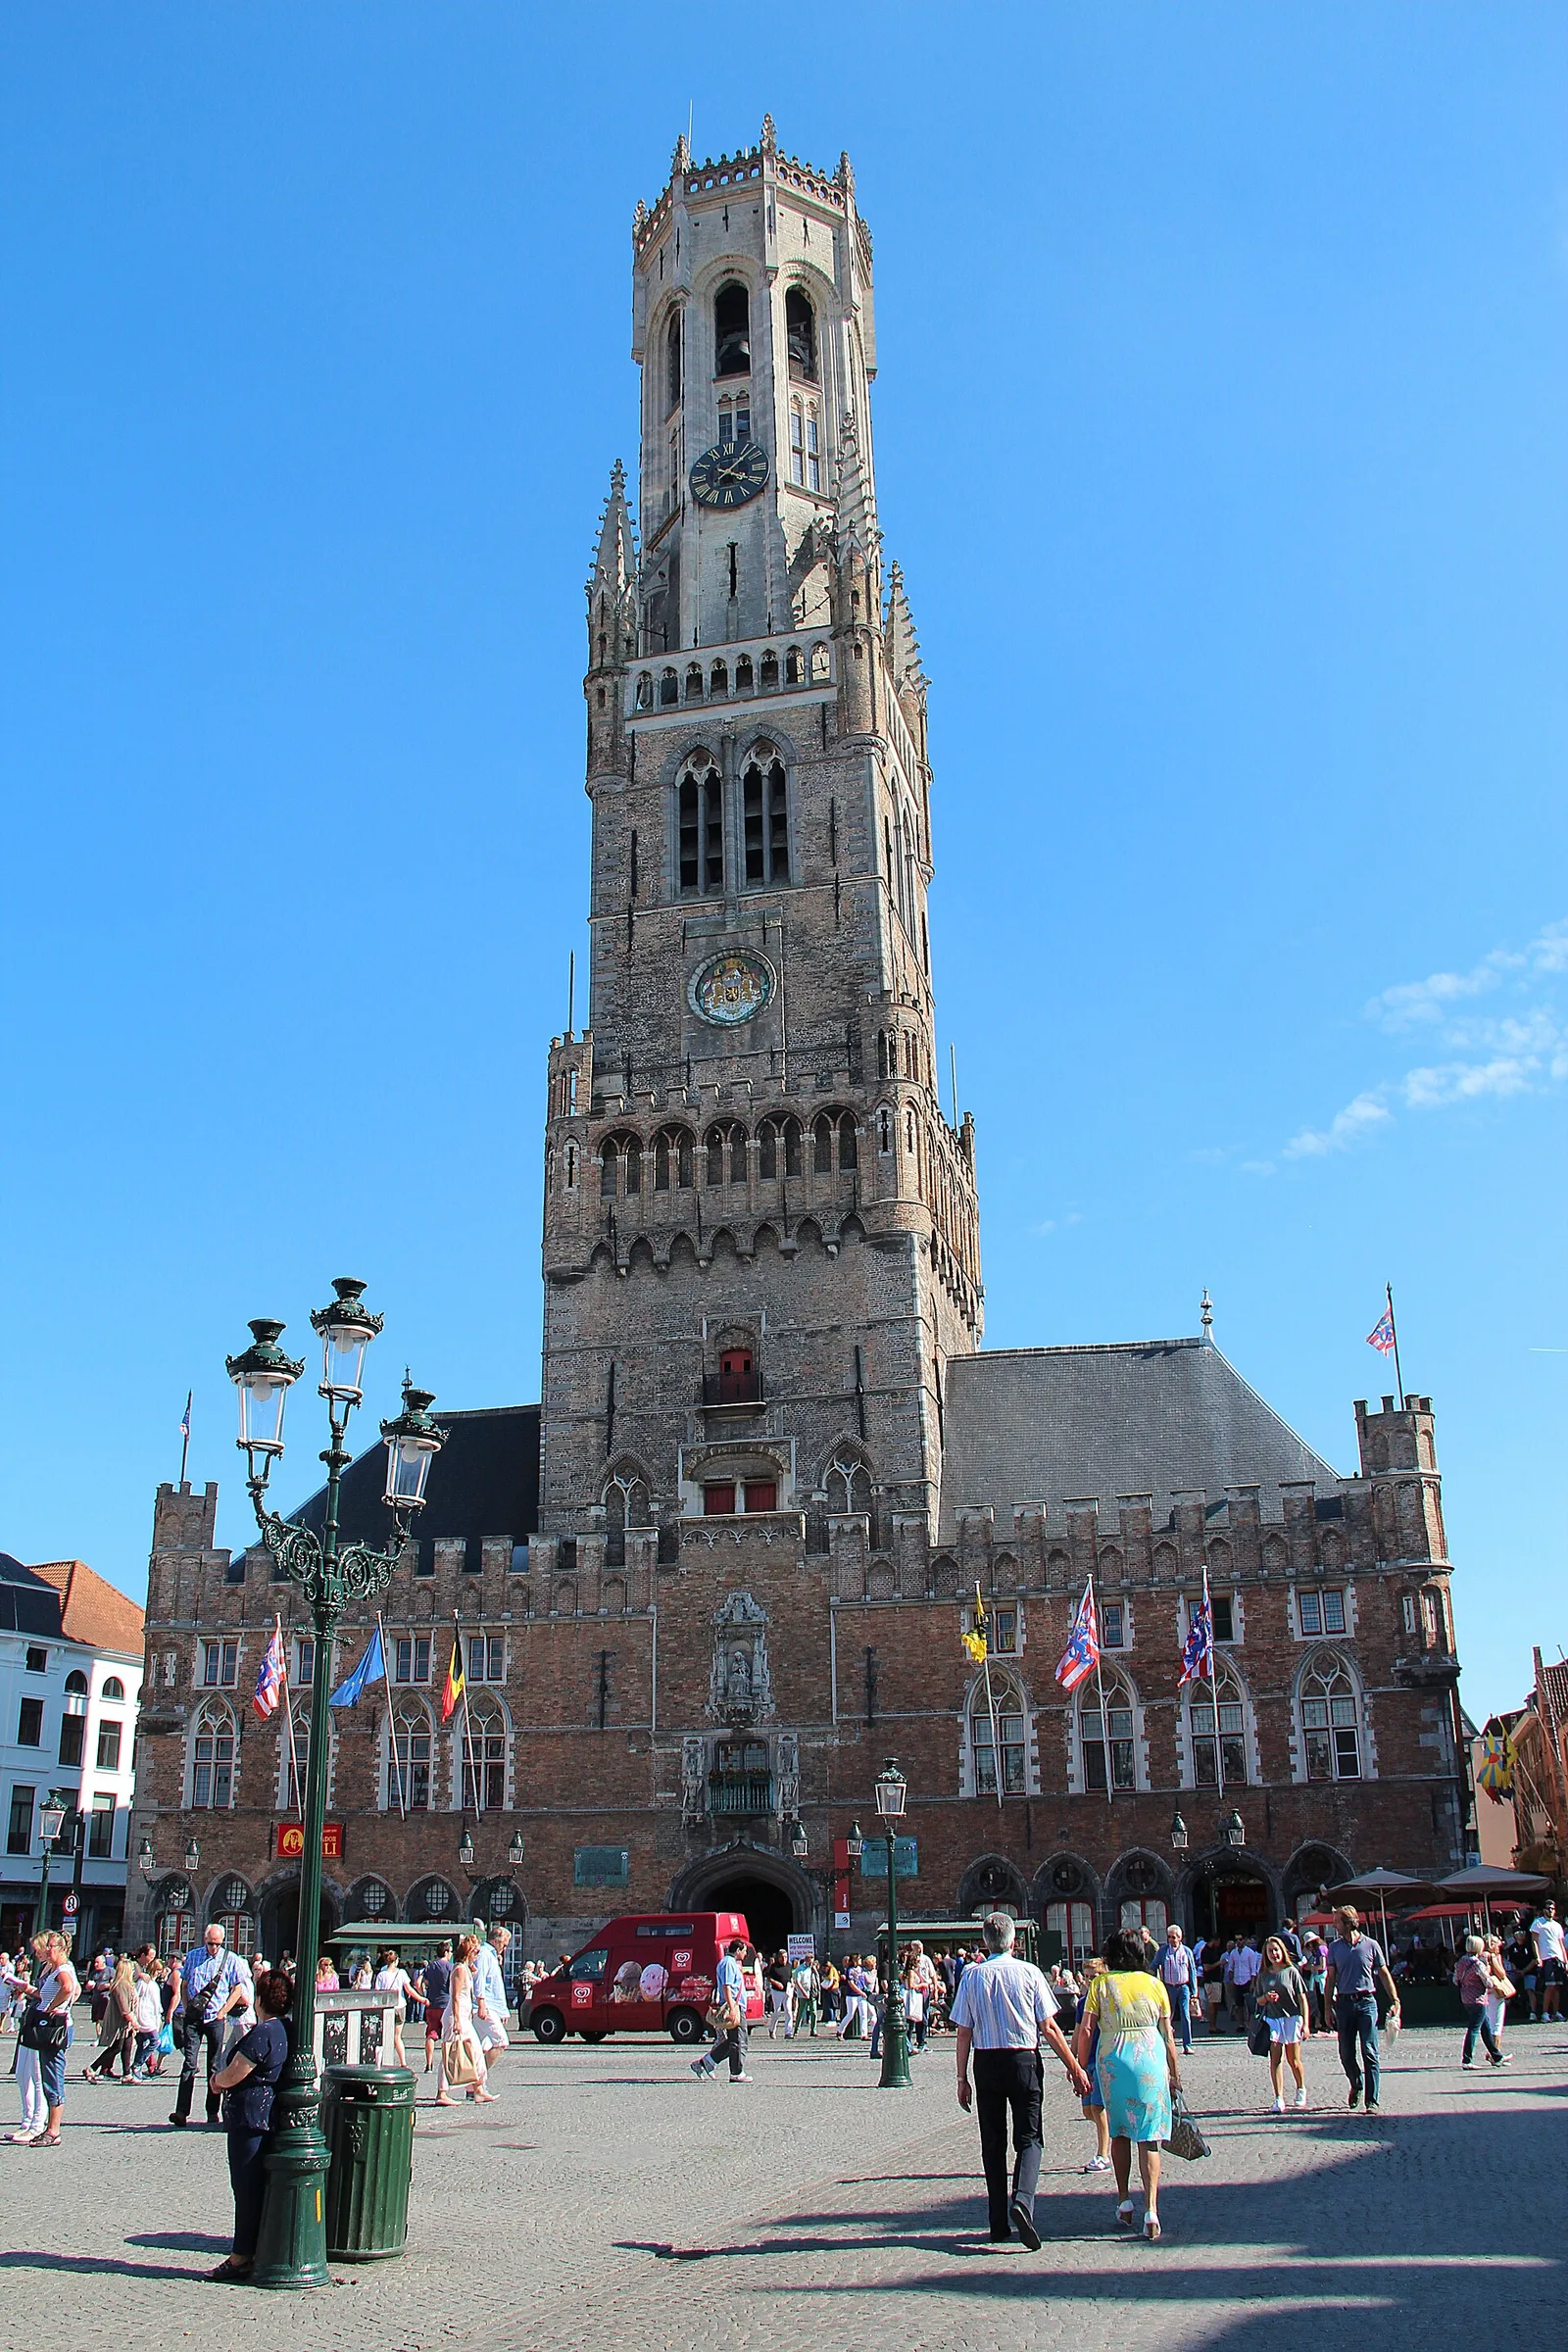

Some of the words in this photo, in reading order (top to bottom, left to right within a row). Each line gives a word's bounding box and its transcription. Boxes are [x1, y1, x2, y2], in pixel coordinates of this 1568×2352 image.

[708, 448, 720, 462] XI
[723, 442, 735, 456] XII
[748, 450, 762, 461] II
[752, 463, 766, 471] III
[322, 1842, 337, 1855] LI
